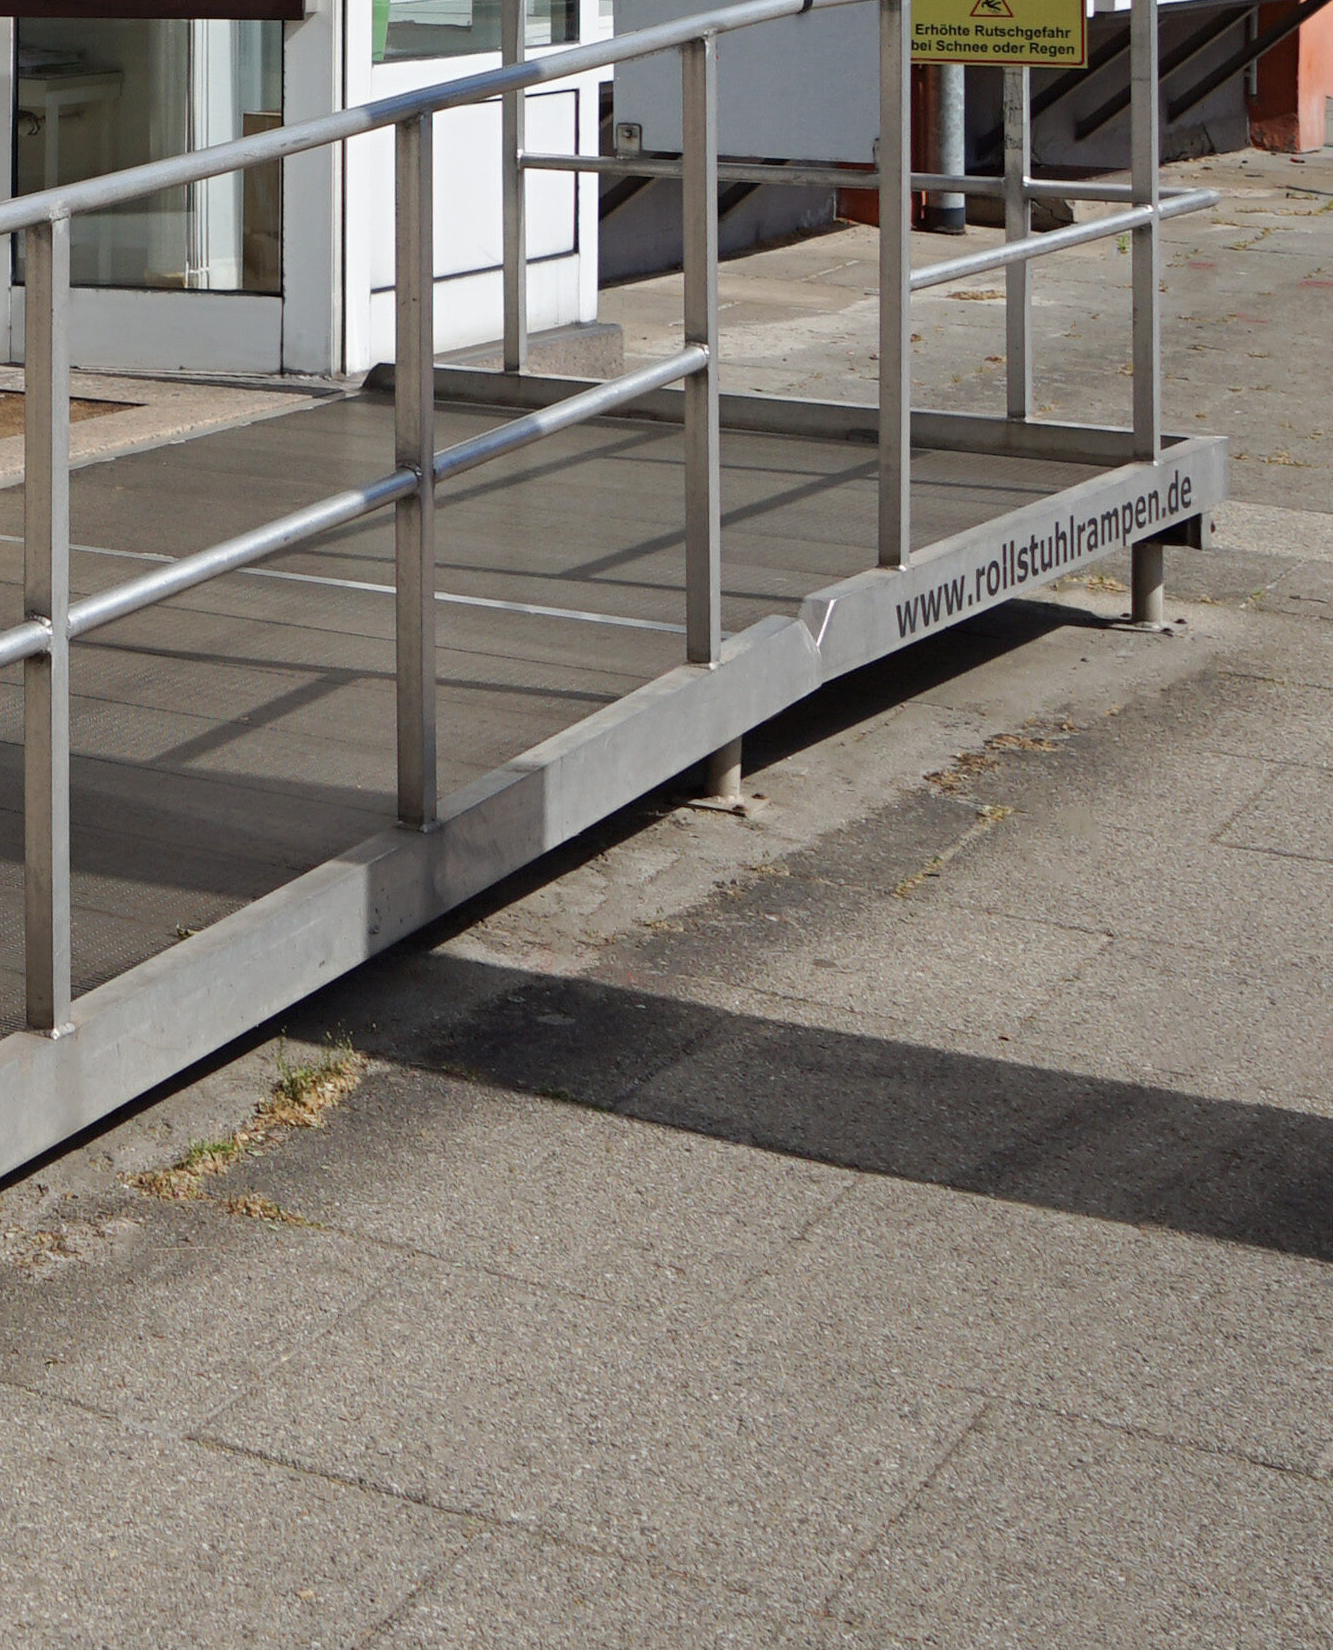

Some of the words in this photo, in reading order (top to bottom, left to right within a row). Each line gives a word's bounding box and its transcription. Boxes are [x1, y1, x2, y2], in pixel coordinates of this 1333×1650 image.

[915, 23, 970, 36] Erhöhte
[975, 24, 1071, 40] Rutschgefahr
[911, 39, 932, 51] bei
[935, 40, 988, 53] Schnee
[992, 41, 1025, 54] oder
[1029, 42, 1075, 57] Regen
[895, 469, 1192, 639] www.rollstuhlrampen.de
